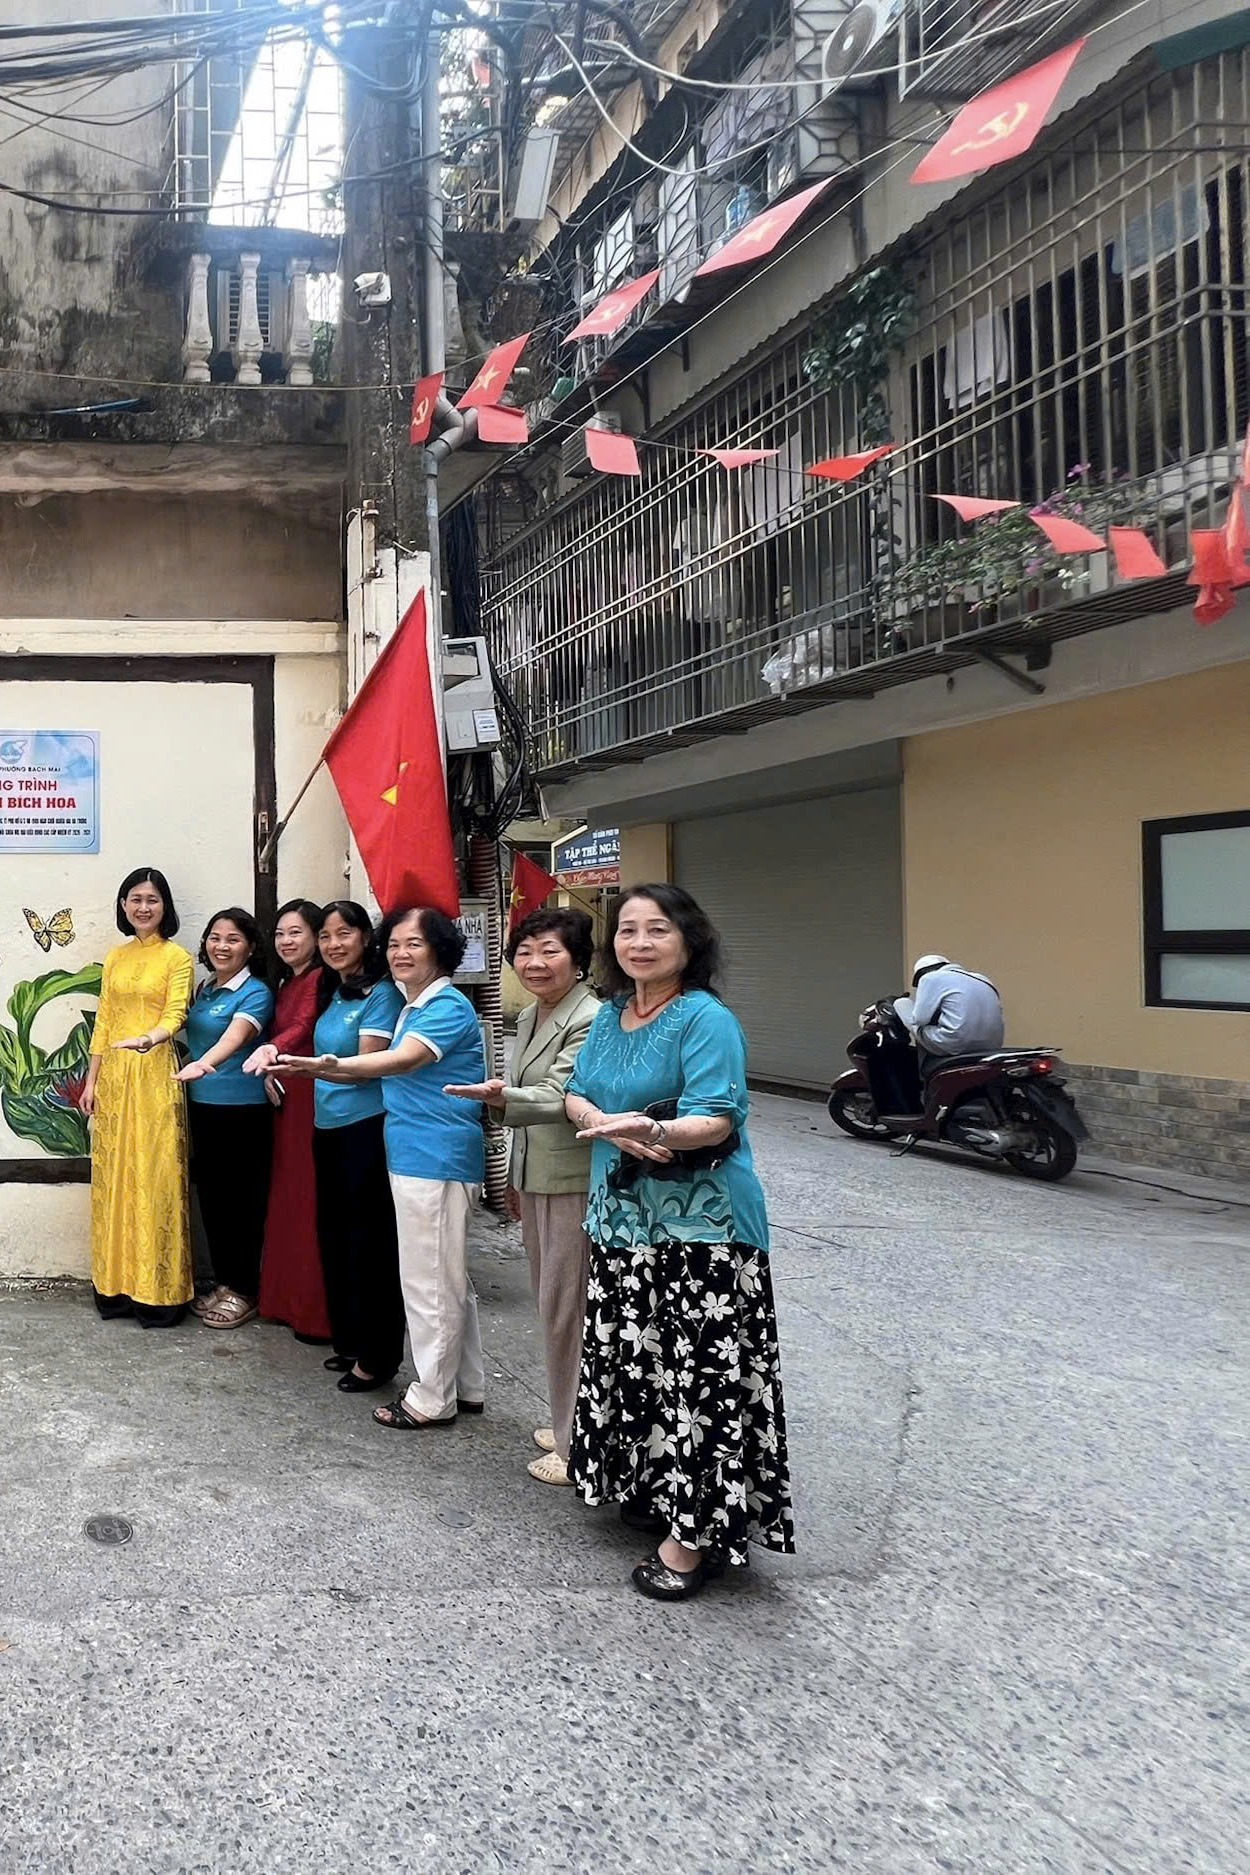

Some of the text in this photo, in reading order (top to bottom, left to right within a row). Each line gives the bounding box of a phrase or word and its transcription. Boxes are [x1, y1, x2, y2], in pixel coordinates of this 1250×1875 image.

[18, 777, 57, 791] TRÌNH
[7, 795, 42, 808] BÍCH
[46, 797, 77, 810] HỌA
[565, 846, 581, 861] TẬP
